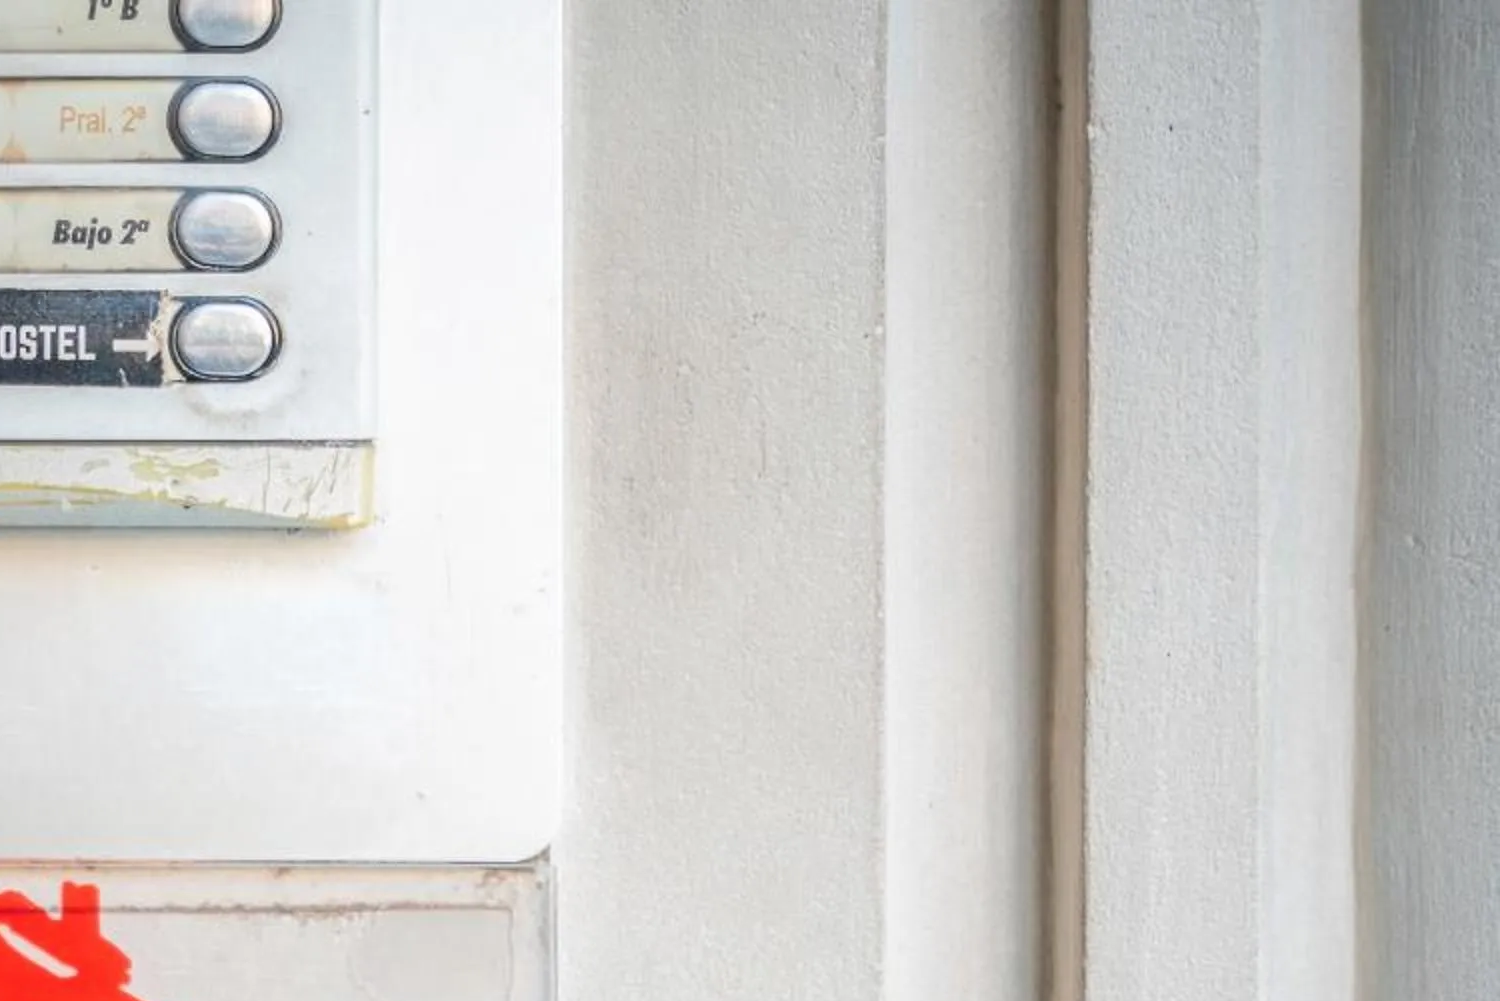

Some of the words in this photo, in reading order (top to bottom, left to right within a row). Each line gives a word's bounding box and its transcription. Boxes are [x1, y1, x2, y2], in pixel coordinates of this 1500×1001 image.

[119, 0, 140, 20] B
[59, 106, 112, 133] Pral.
[52, 218, 113, 250] Bajo
